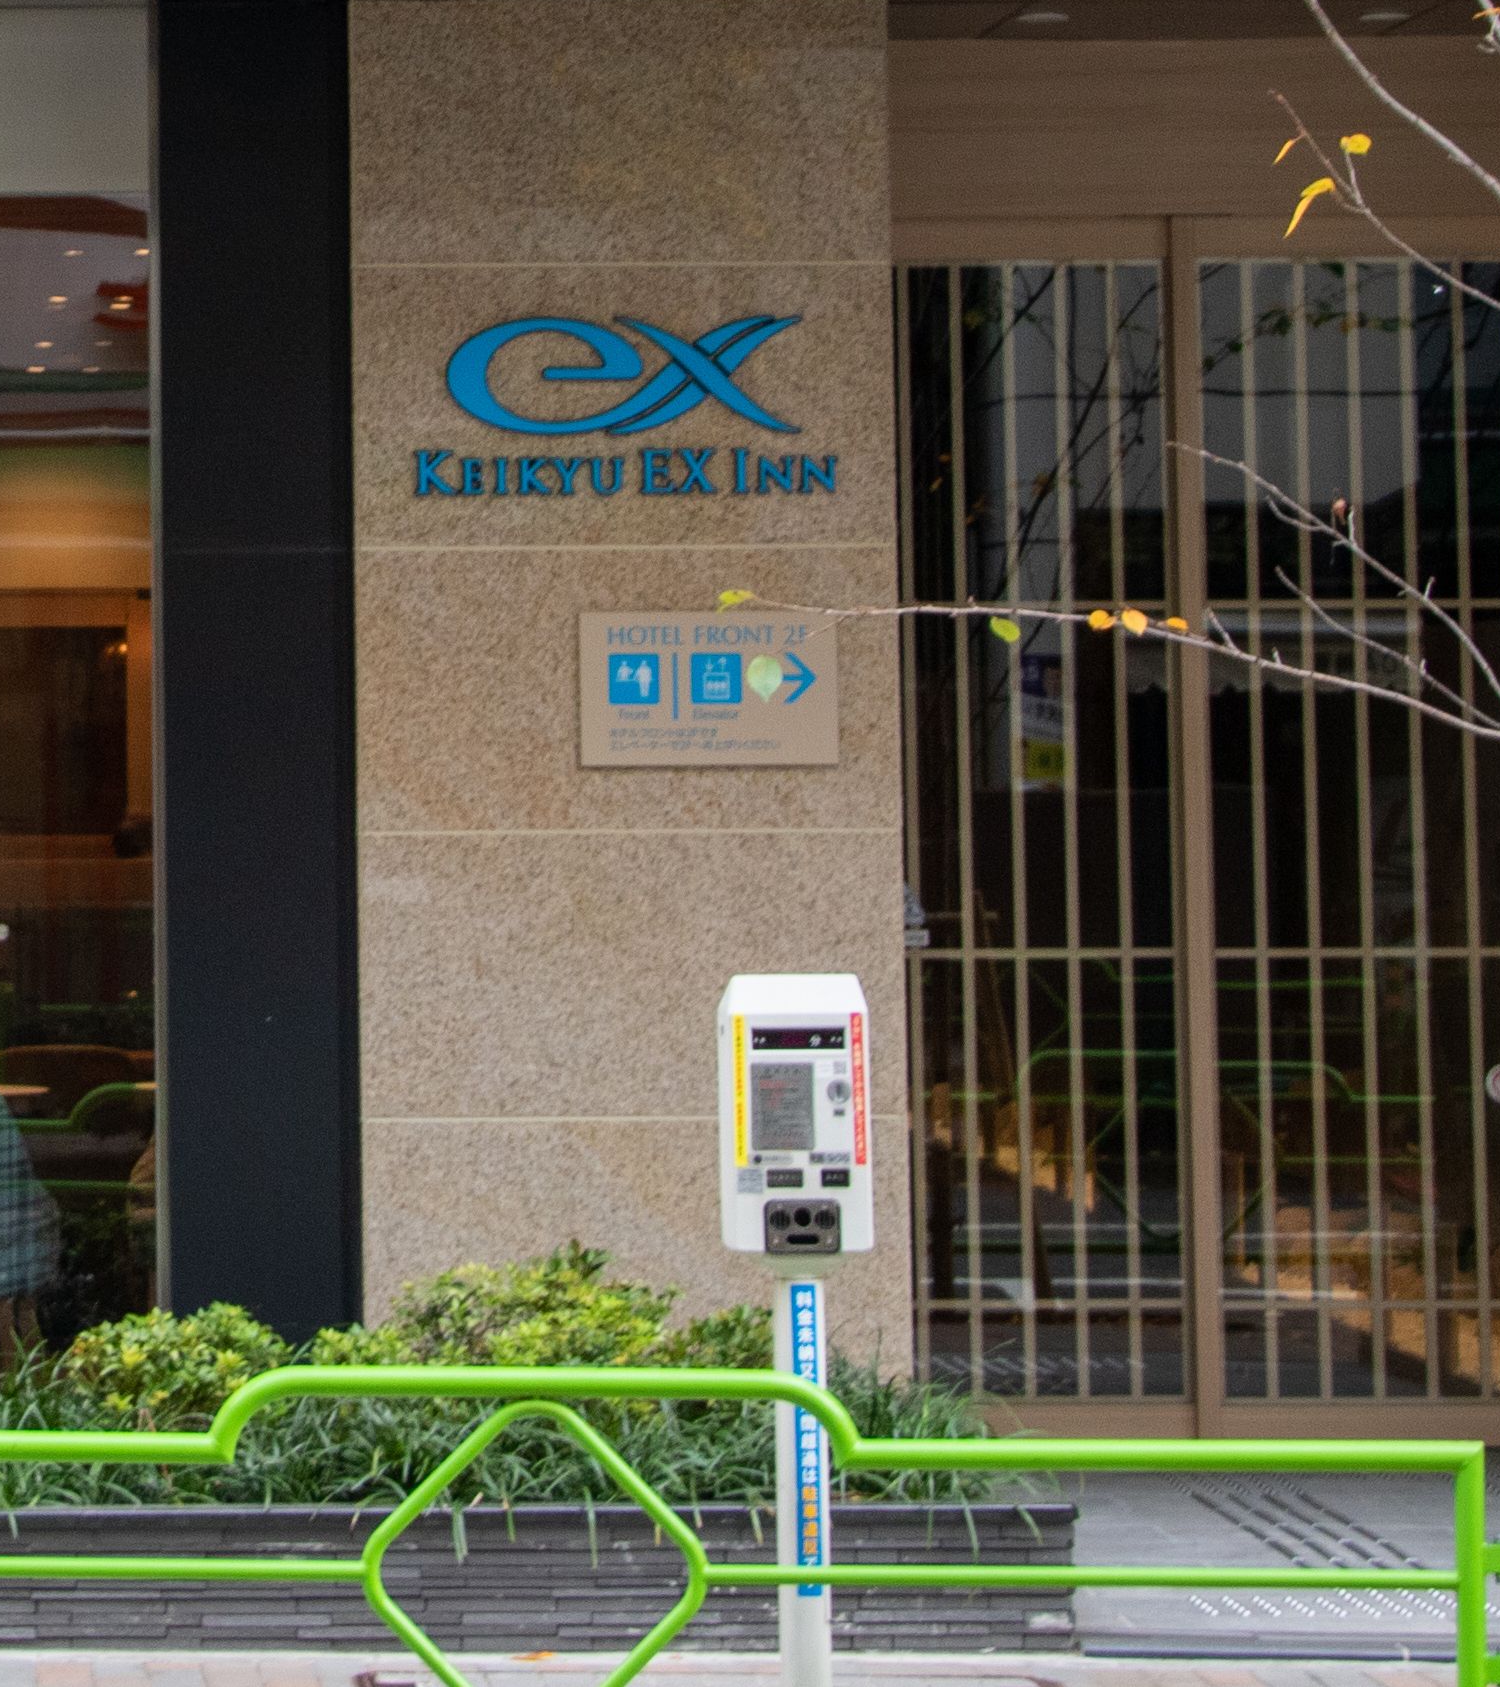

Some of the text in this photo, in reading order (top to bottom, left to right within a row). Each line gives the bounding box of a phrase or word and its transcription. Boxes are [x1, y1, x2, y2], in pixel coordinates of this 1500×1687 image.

[416, 447, 837, 496] KEIKYU EX INN
[606, 625, 683, 646] HOTEL
[693, 624, 775, 645] FRONT
